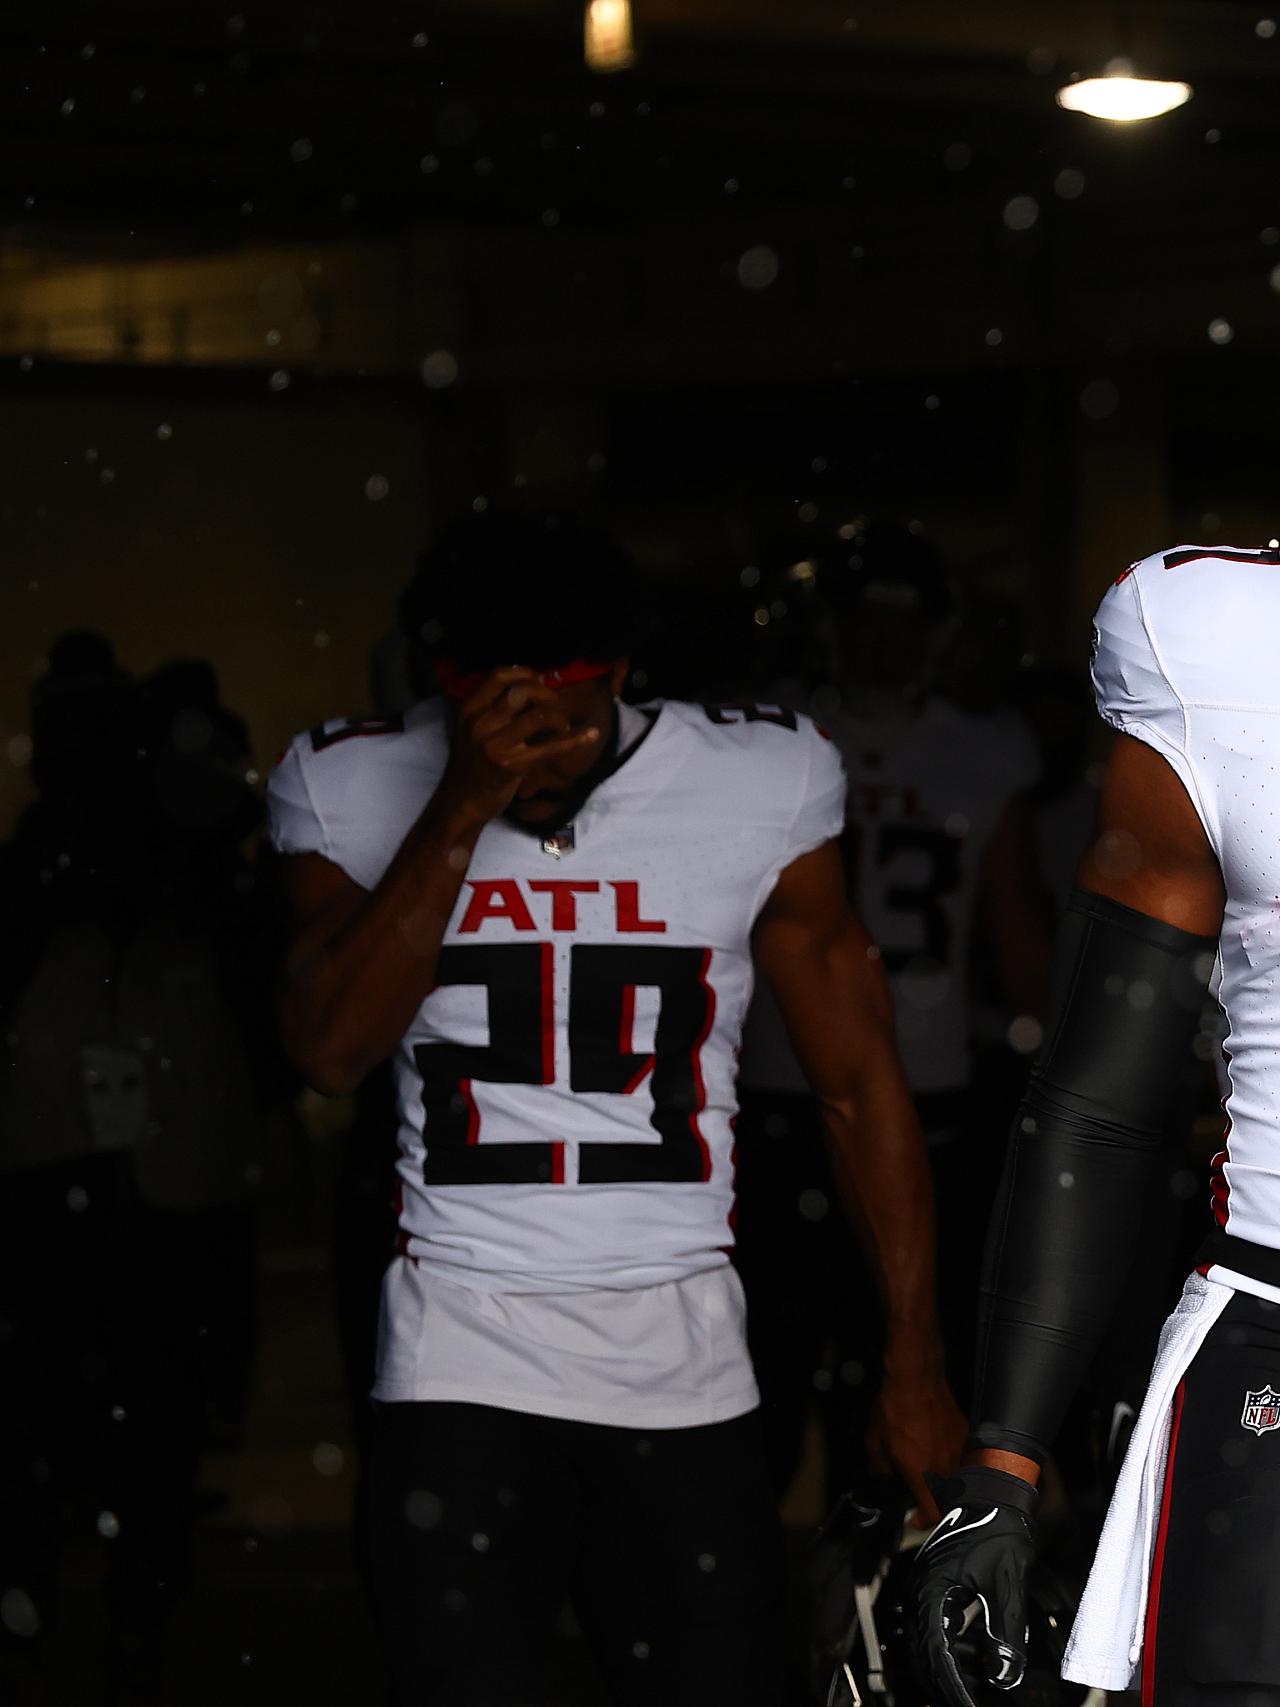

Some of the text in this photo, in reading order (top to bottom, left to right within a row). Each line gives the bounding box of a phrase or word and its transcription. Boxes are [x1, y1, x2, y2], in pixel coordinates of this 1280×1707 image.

[457, 878, 666, 933] ATL
[414, 942, 716, 1185] 29
[1246, 1408, 1276, 1428] NFL
